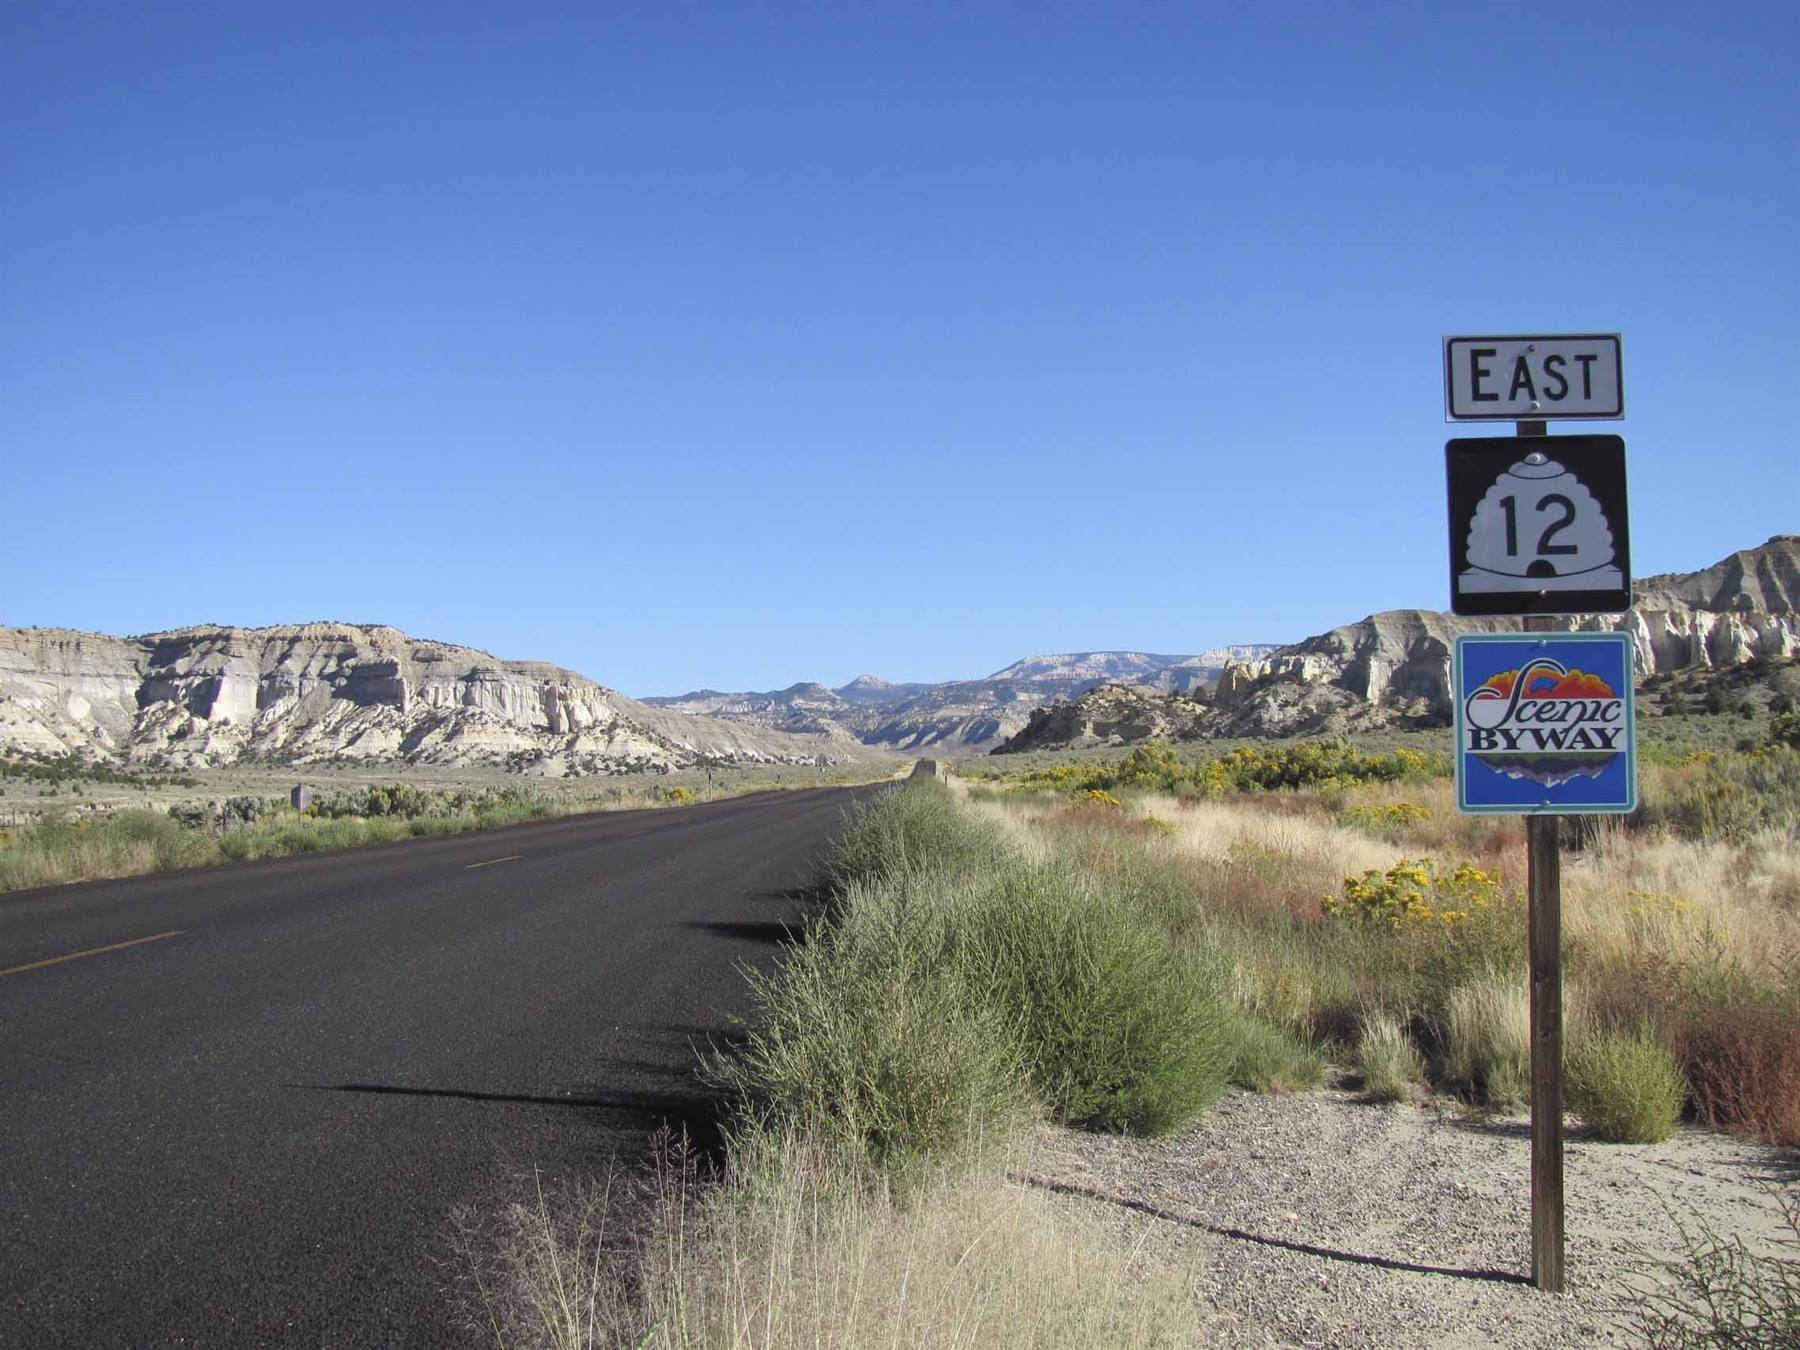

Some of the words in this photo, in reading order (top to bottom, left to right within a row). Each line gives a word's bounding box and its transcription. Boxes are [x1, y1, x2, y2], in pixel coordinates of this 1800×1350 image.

[1470, 348, 1598, 402] EAST
[1500, 493, 1578, 556] 12
[1465, 657, 1622, 734] Scenic
[1467, 727, 1624, 750] BYWAY
